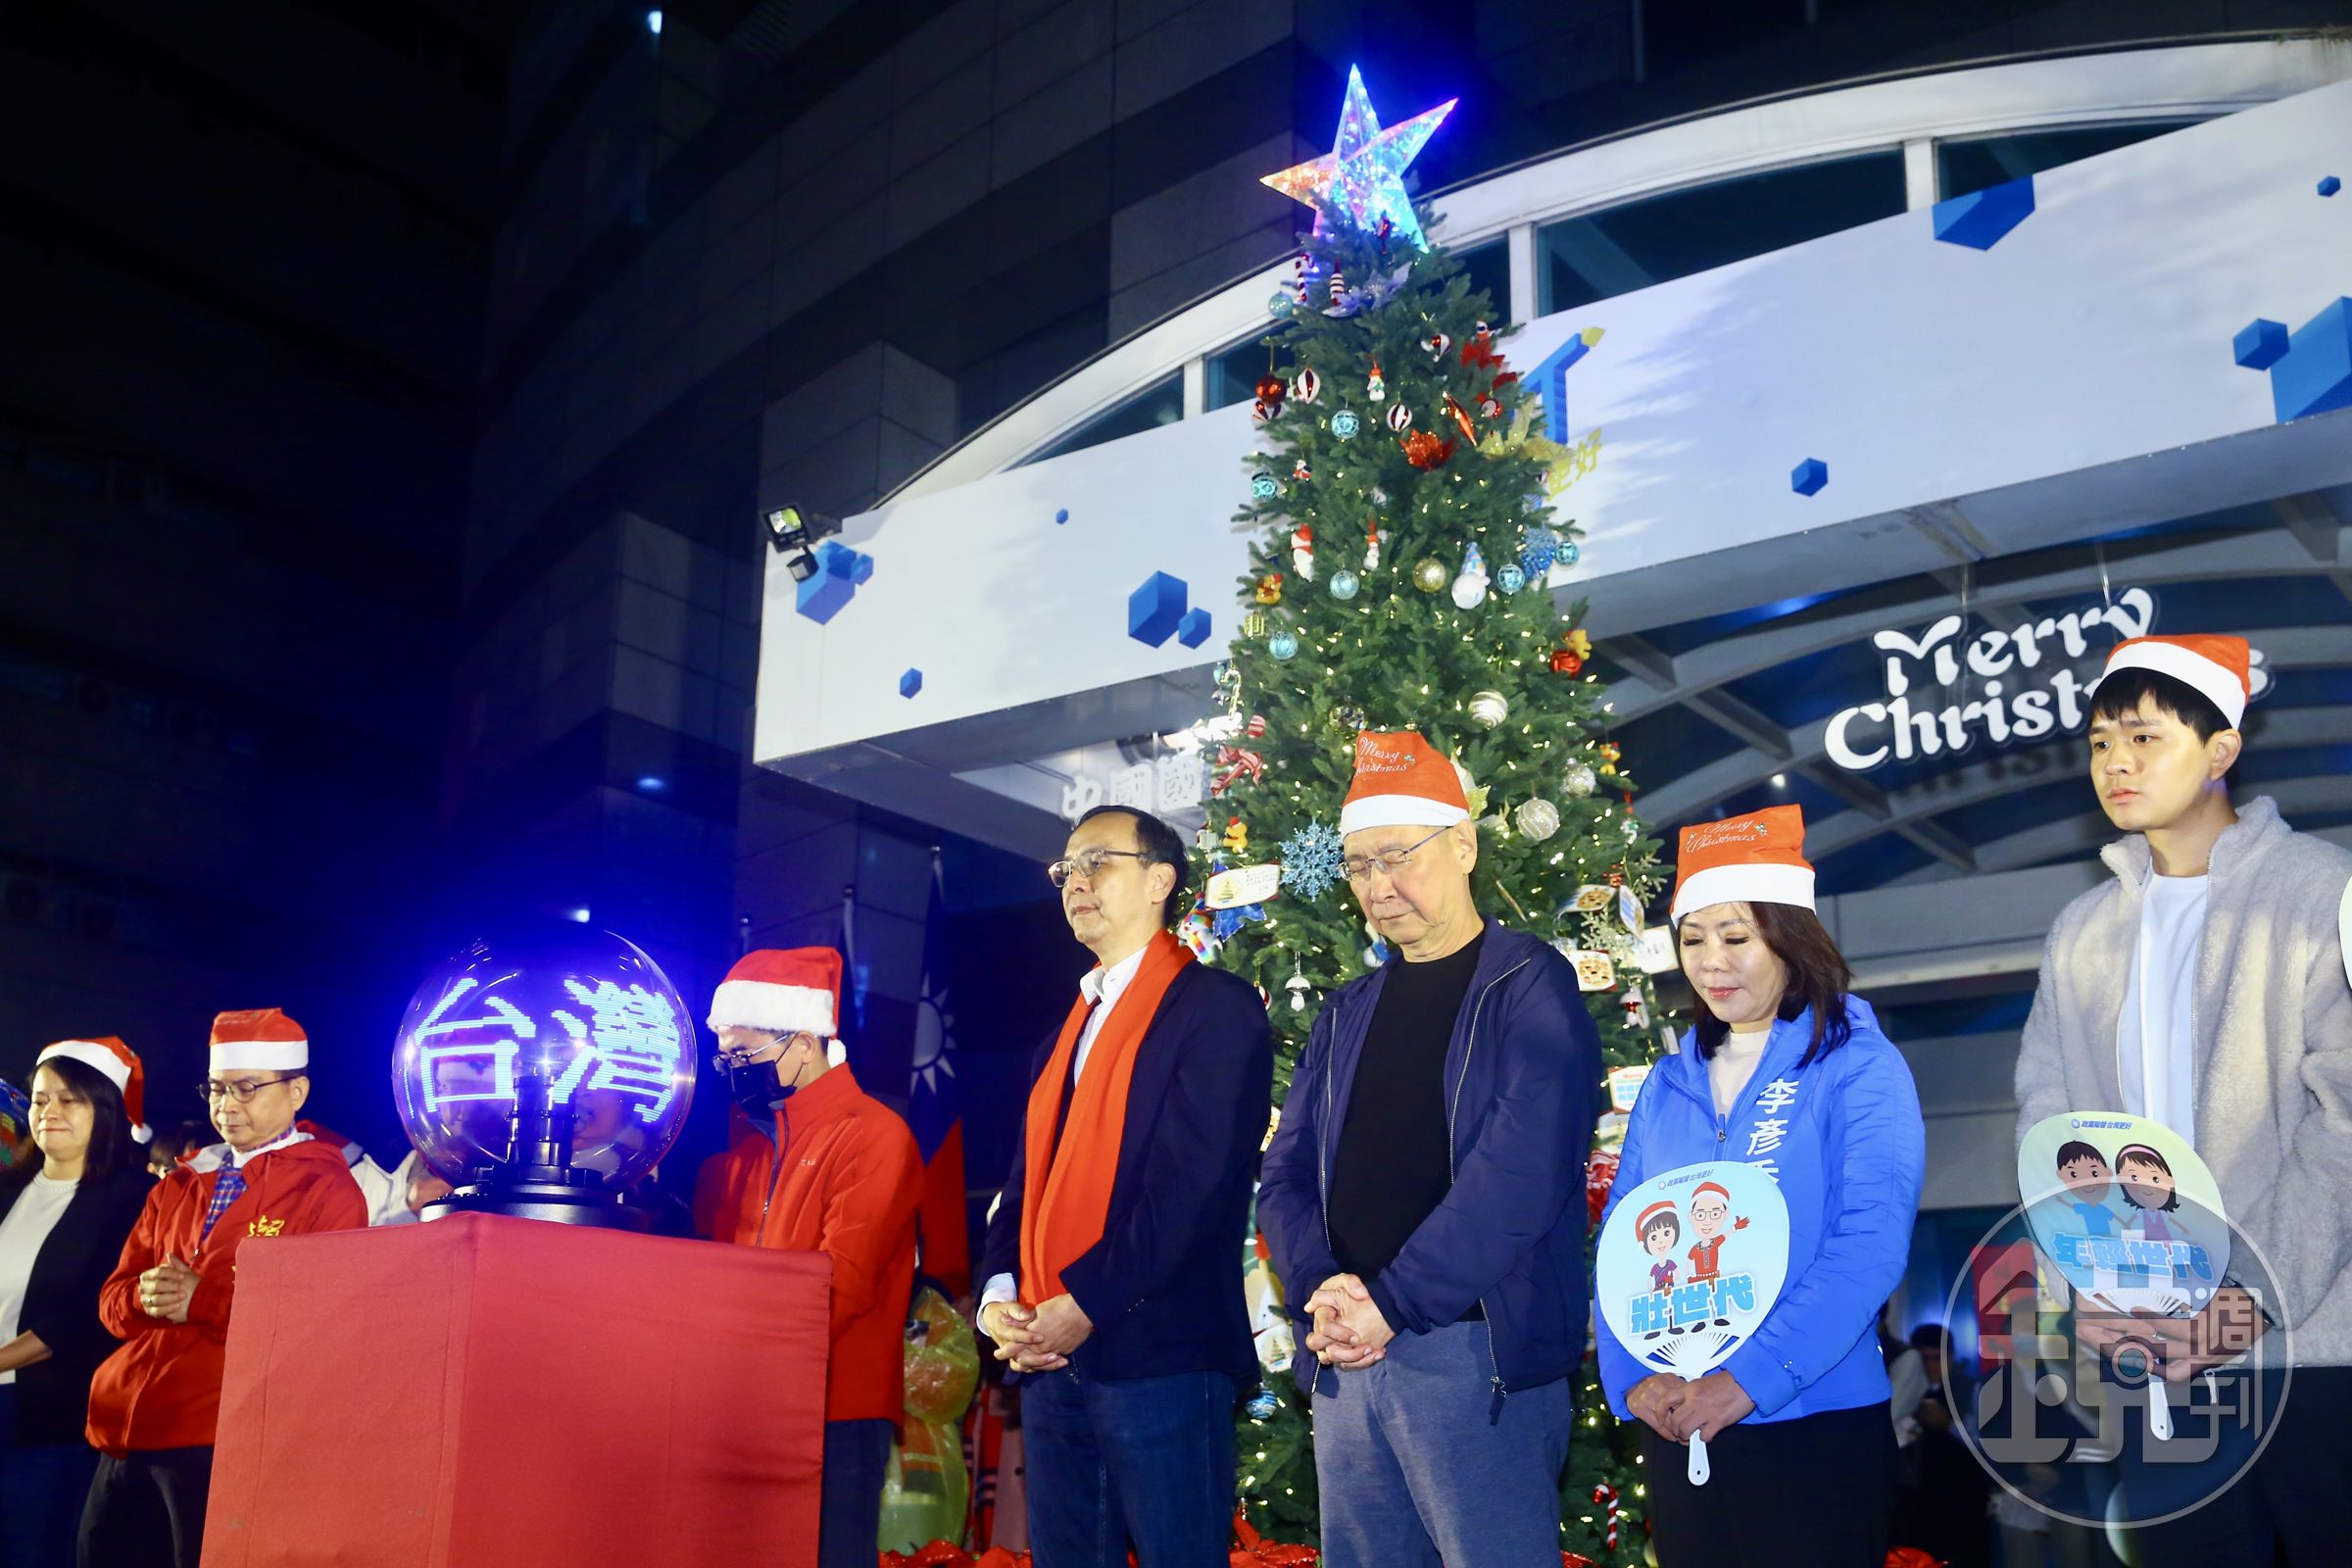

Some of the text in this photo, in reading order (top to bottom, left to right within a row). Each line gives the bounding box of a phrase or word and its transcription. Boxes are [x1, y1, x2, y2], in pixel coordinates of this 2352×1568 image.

[1874, 588, 2156, 690] Merry
[1359, 736, 1399, 762] Merry
[1824, 648, 2272, 770] Christ
[413, 977, 682, 1123] 台灣
[2053, 1232, 2214, 1283] 年輕世代
[1630, 1272, 1755, 1336] 壯世代
